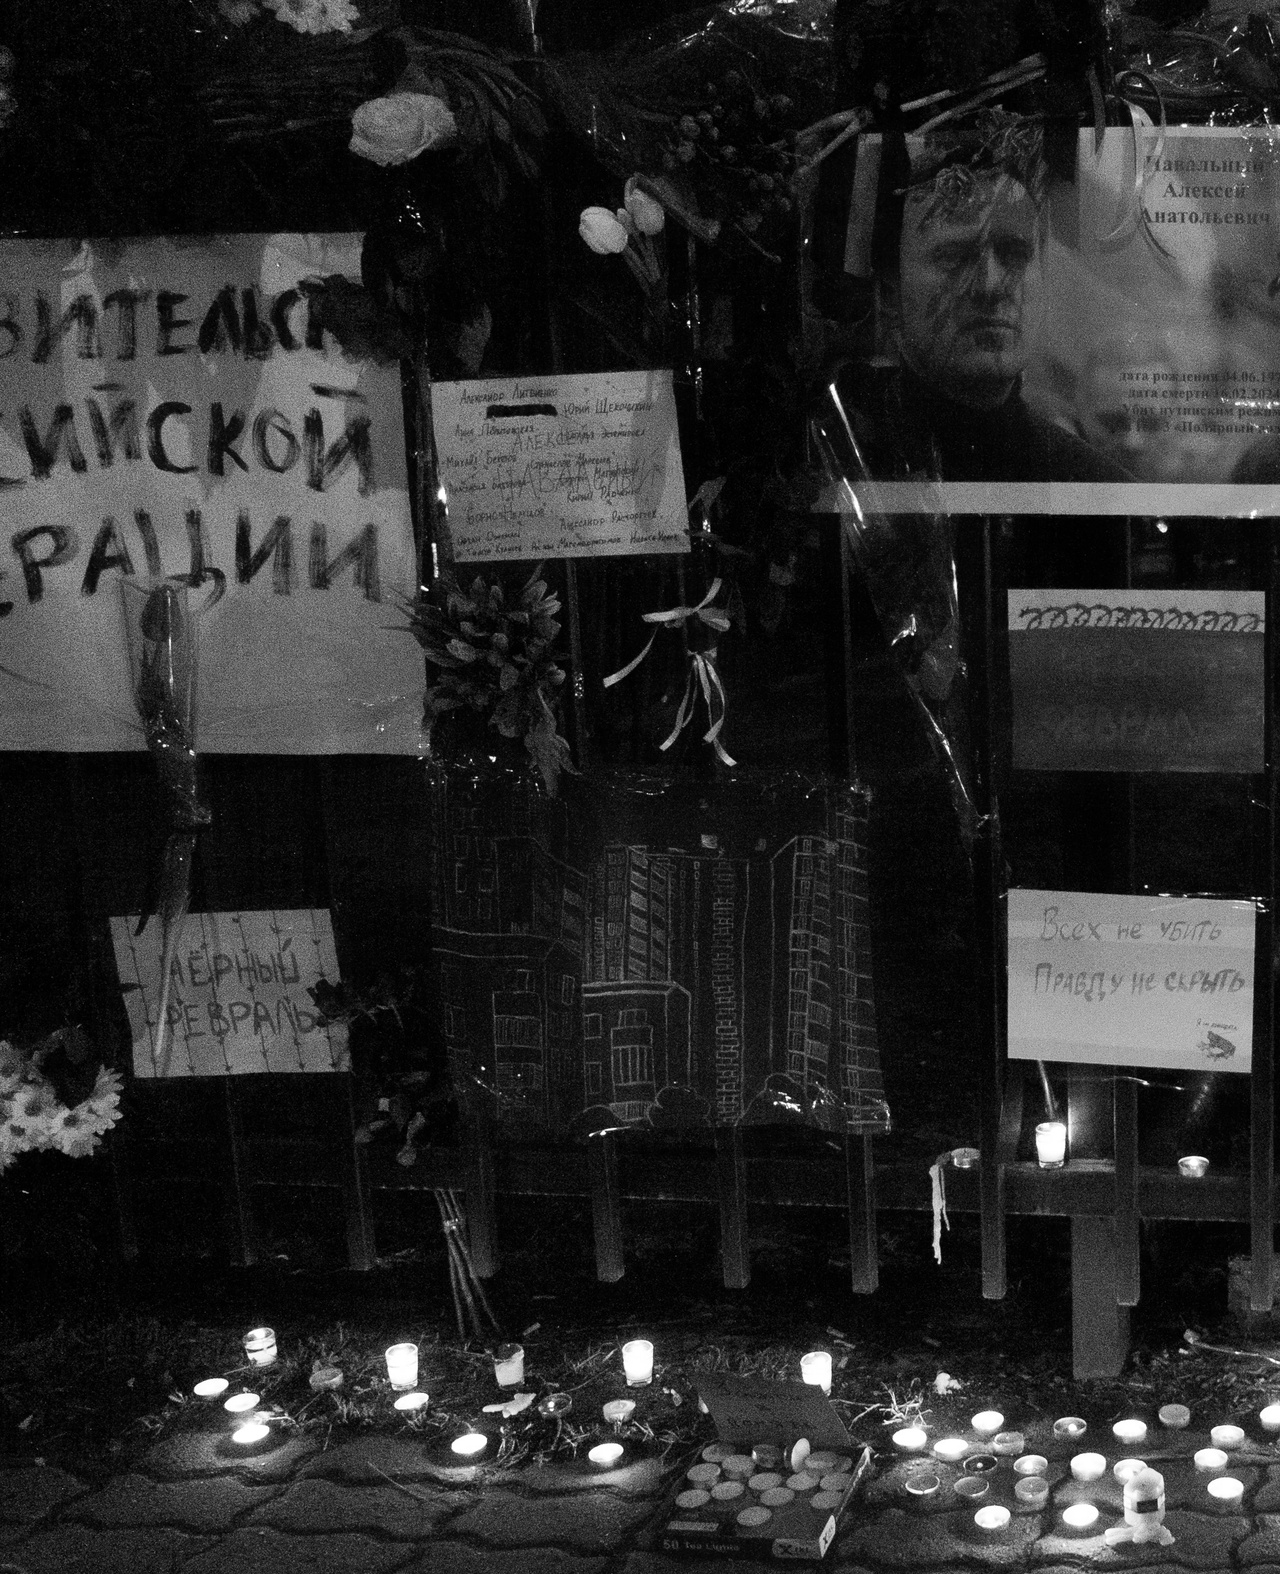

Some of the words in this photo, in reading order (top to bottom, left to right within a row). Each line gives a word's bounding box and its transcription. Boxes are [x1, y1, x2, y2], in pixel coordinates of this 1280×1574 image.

[1162, 182, 1247, 199] Алексей
[1141, 206, 1271, 225] Анатольевич
[0, 384, 376, 498] ИЙСКОЙ
[0, 508, 382, 616] РАЦИИ
[1038, 905, 1103, 943] Всех
